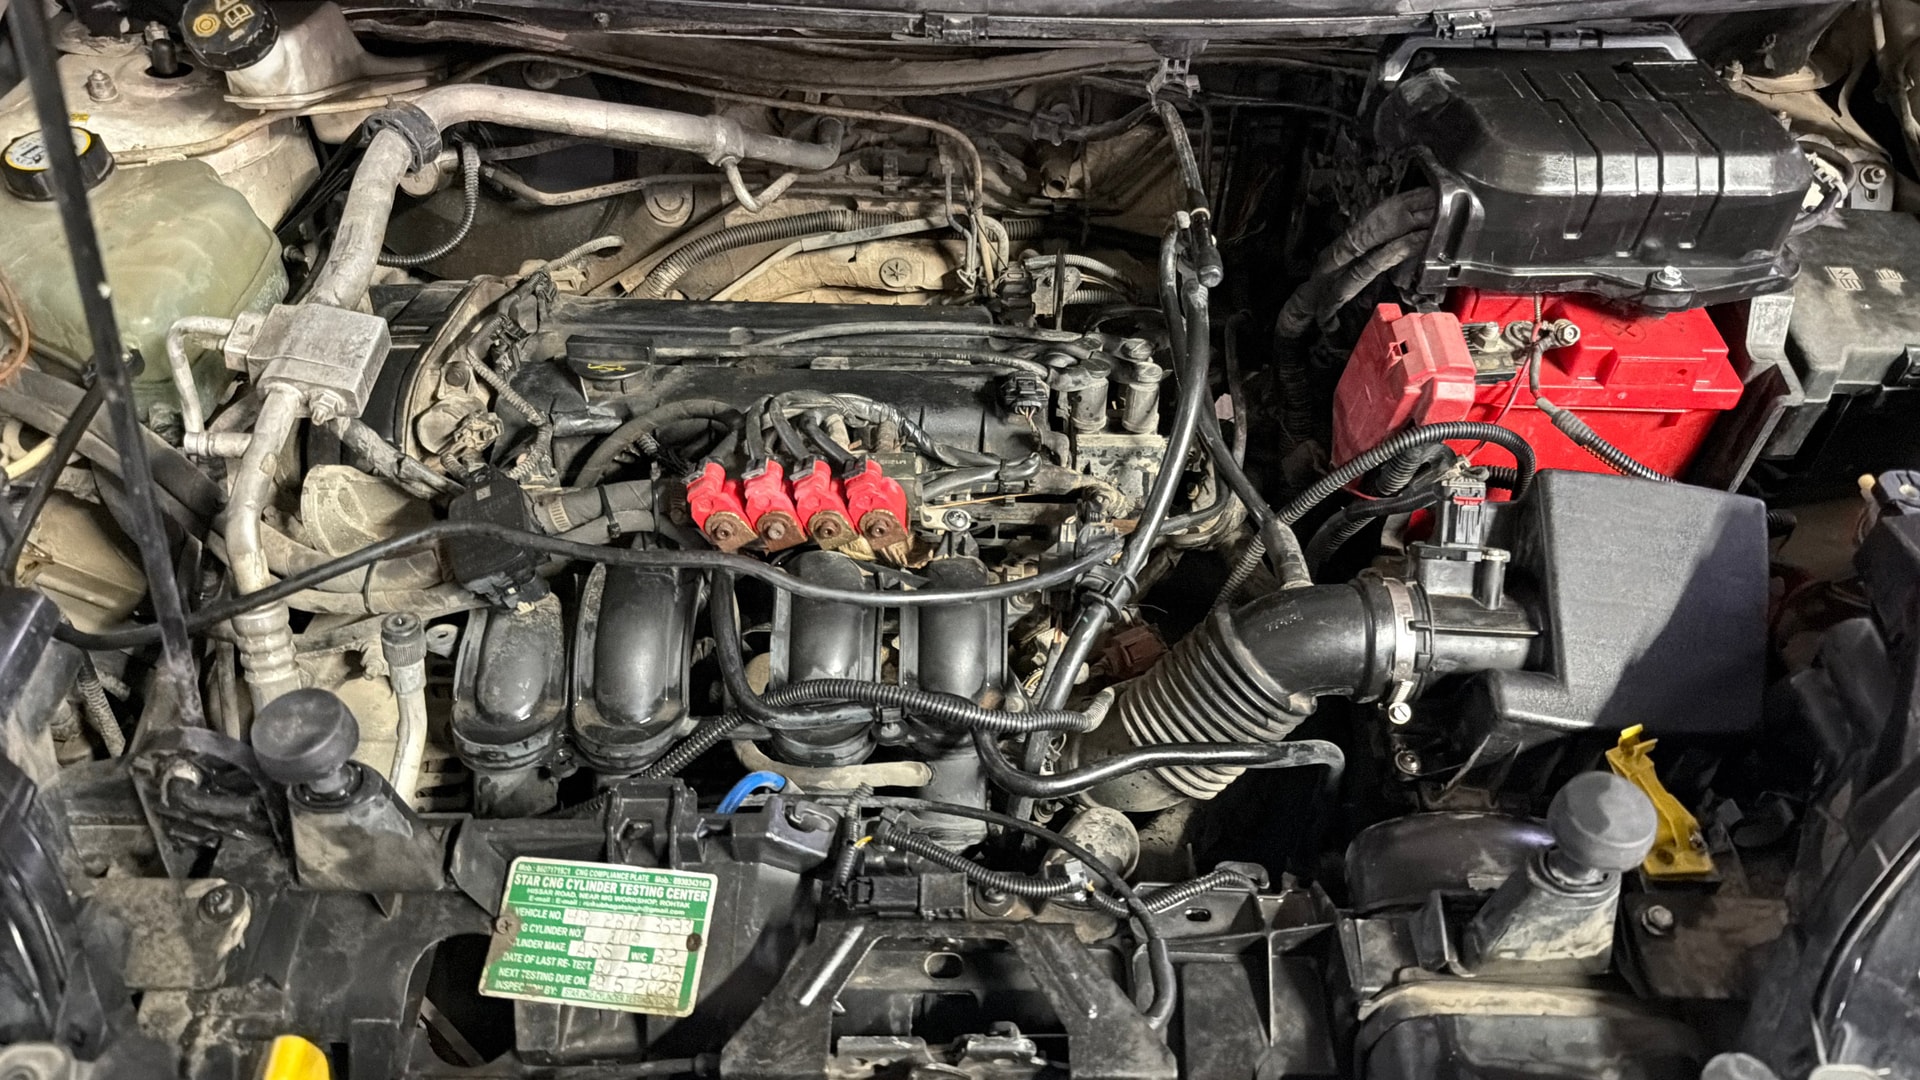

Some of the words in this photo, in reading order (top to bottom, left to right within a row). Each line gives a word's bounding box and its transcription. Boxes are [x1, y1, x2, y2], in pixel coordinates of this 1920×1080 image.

[630, 872, 650, 882] PLATE
[514, 873, 540, 887] STAR
[542, 876, 565, 889] CNG
[565, 878, 618, 894] CYLINDER
[620, 883, 665, 898] TESTING
[666, 888, 708, 902] CENTER
[579, 892, 600, 900] NEAR
[659, 900, 691, 909] ROHTAK
[515, 906, 549, 919] VEHICLE
[529, 923, 568, 936] CYLINDER
[502, 952, 523, 963] DATE
[523, 954, 535, 964] OF
[536, 954, 556, 966] LAST
[498, 967, 520, 978] NEXT
[521, 969, 555, 983] TESTING
[555, 973, 573, 984] DUE
